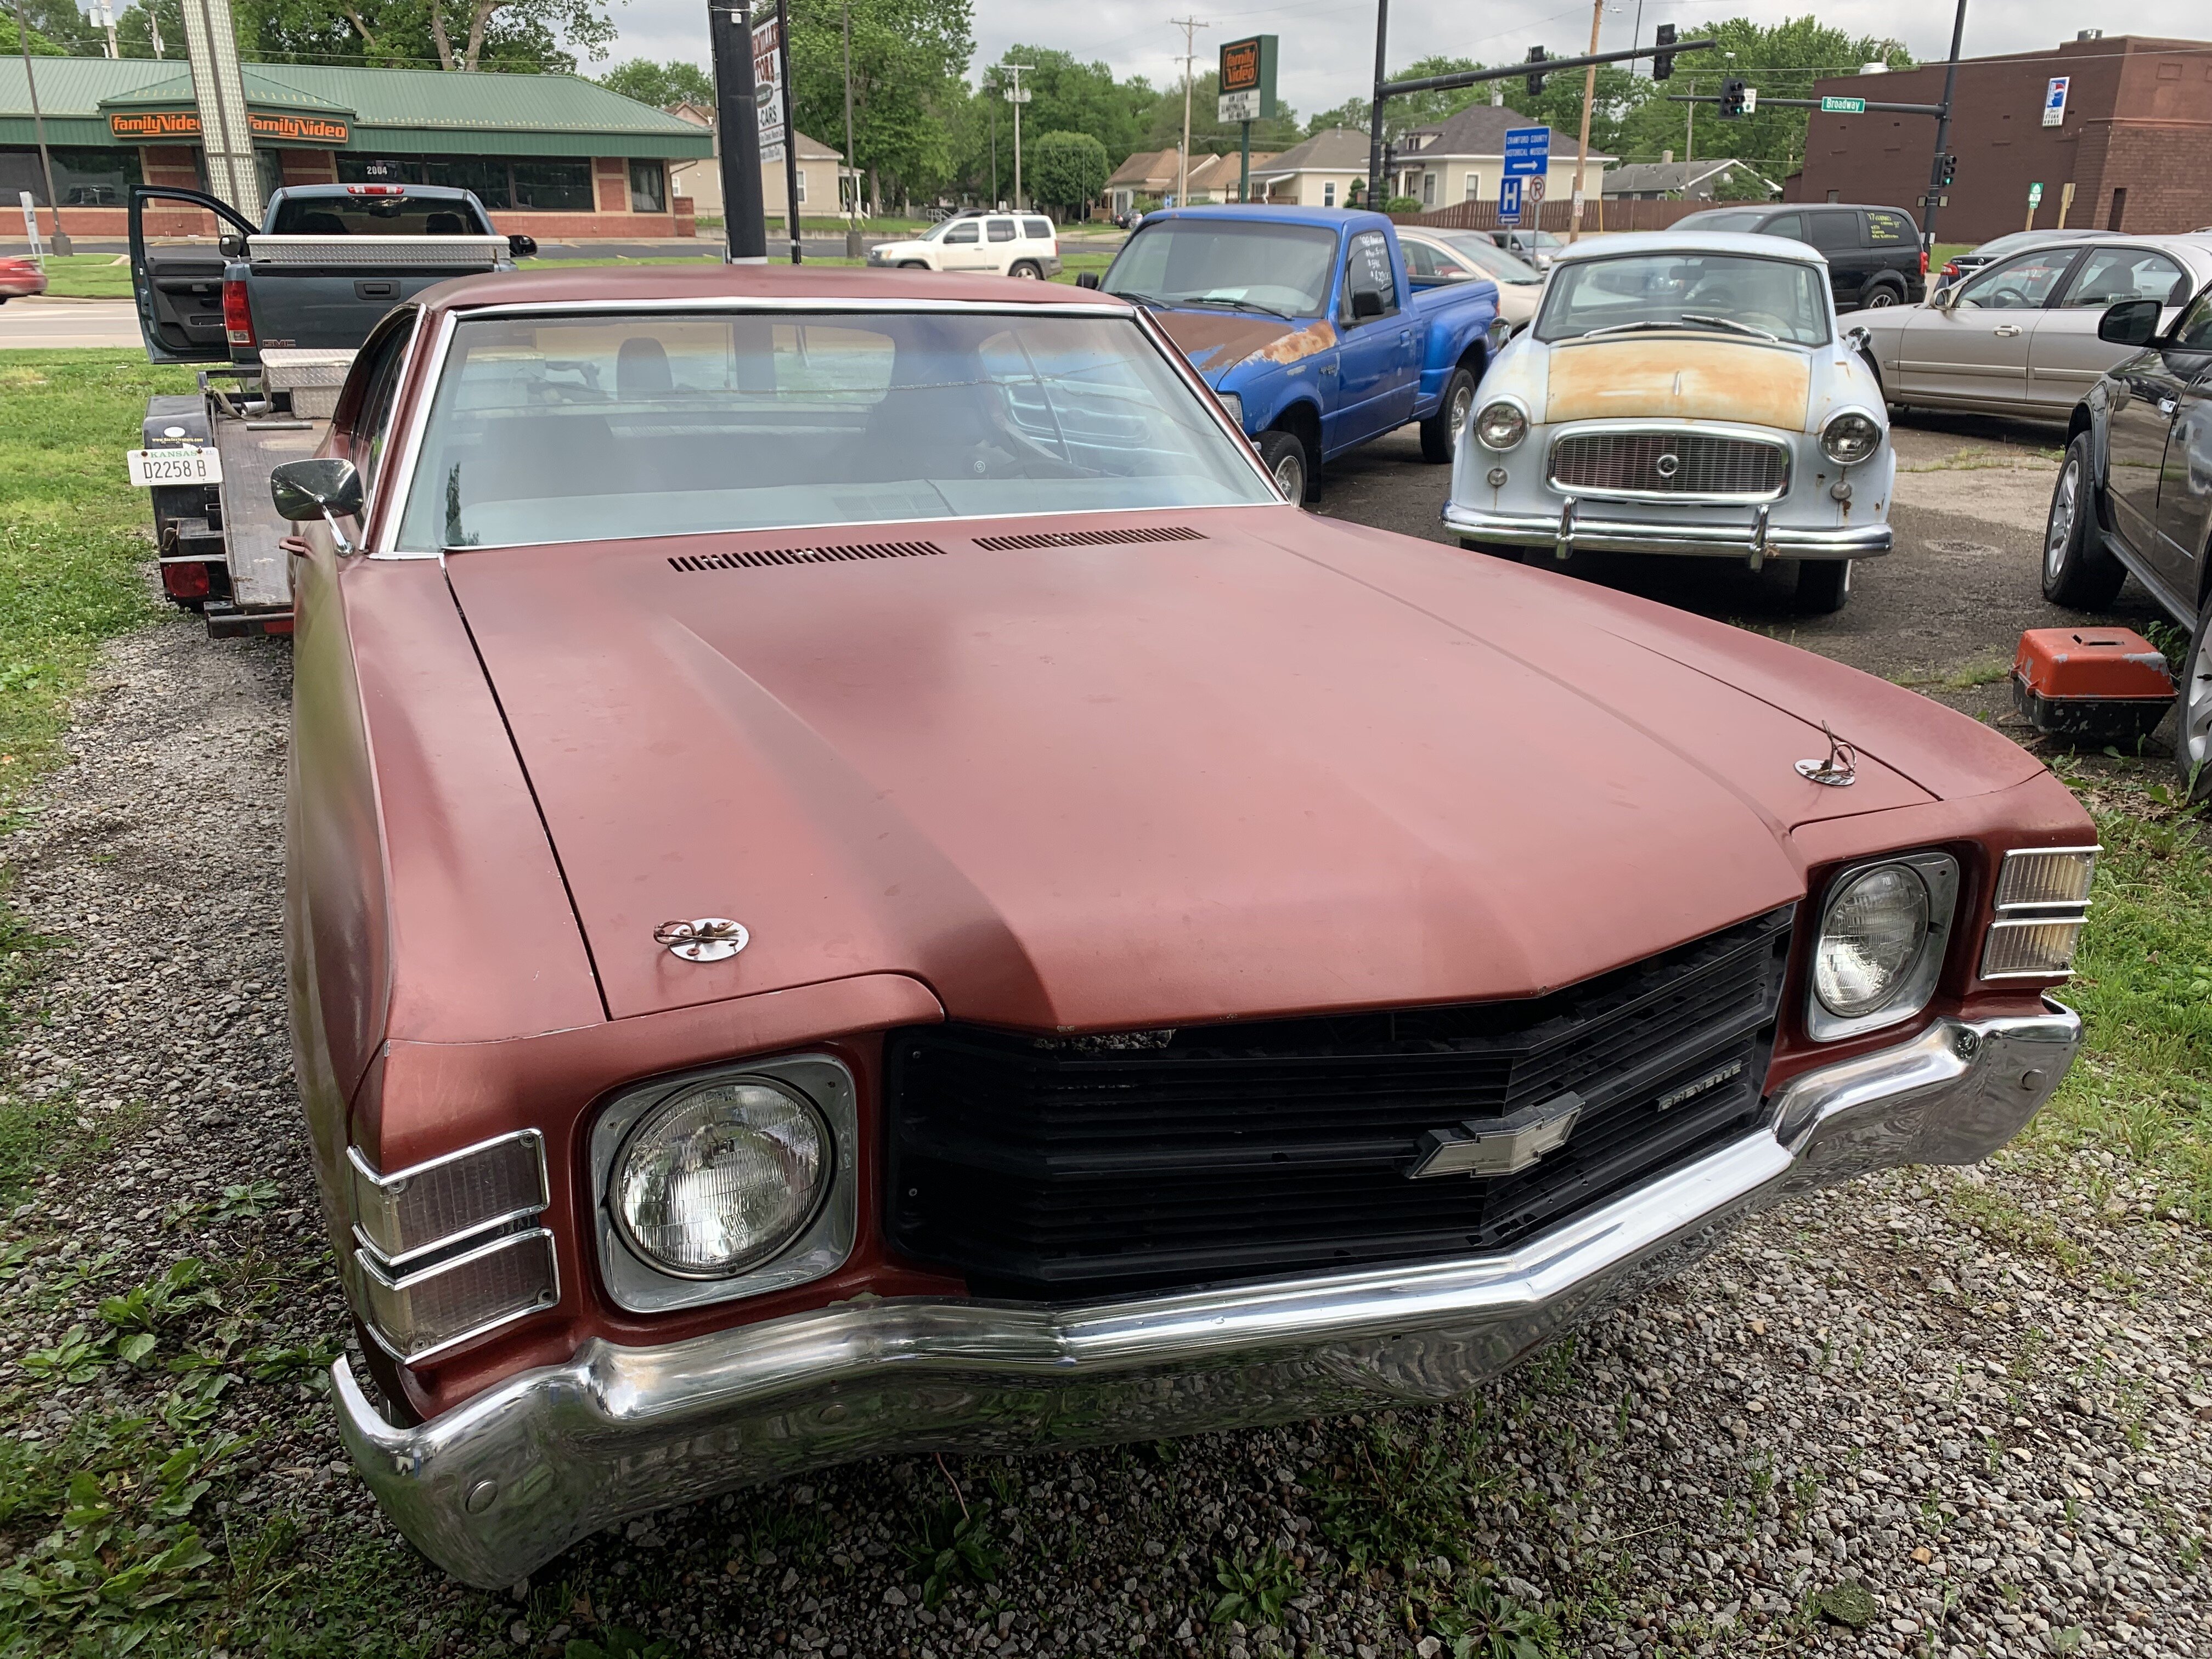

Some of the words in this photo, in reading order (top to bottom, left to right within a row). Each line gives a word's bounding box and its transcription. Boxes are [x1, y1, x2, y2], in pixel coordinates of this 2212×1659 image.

[1226, 65, 1255, 83] Video
[1826, 98, 1860, 111] Broadway
[114, 115, 201, 133] familyVide
[760, 105, 777, 127] CARS
[1531, 134, 1548, 143] COUNTY
[366, 166, 387, 174] 2004
[1504, 182, 1518, 211] H
[143, 461, 191, 479] D2258
[196, 460, 206, 477] B
[1658, 1063, 1742, 1112] CHEVELLE
